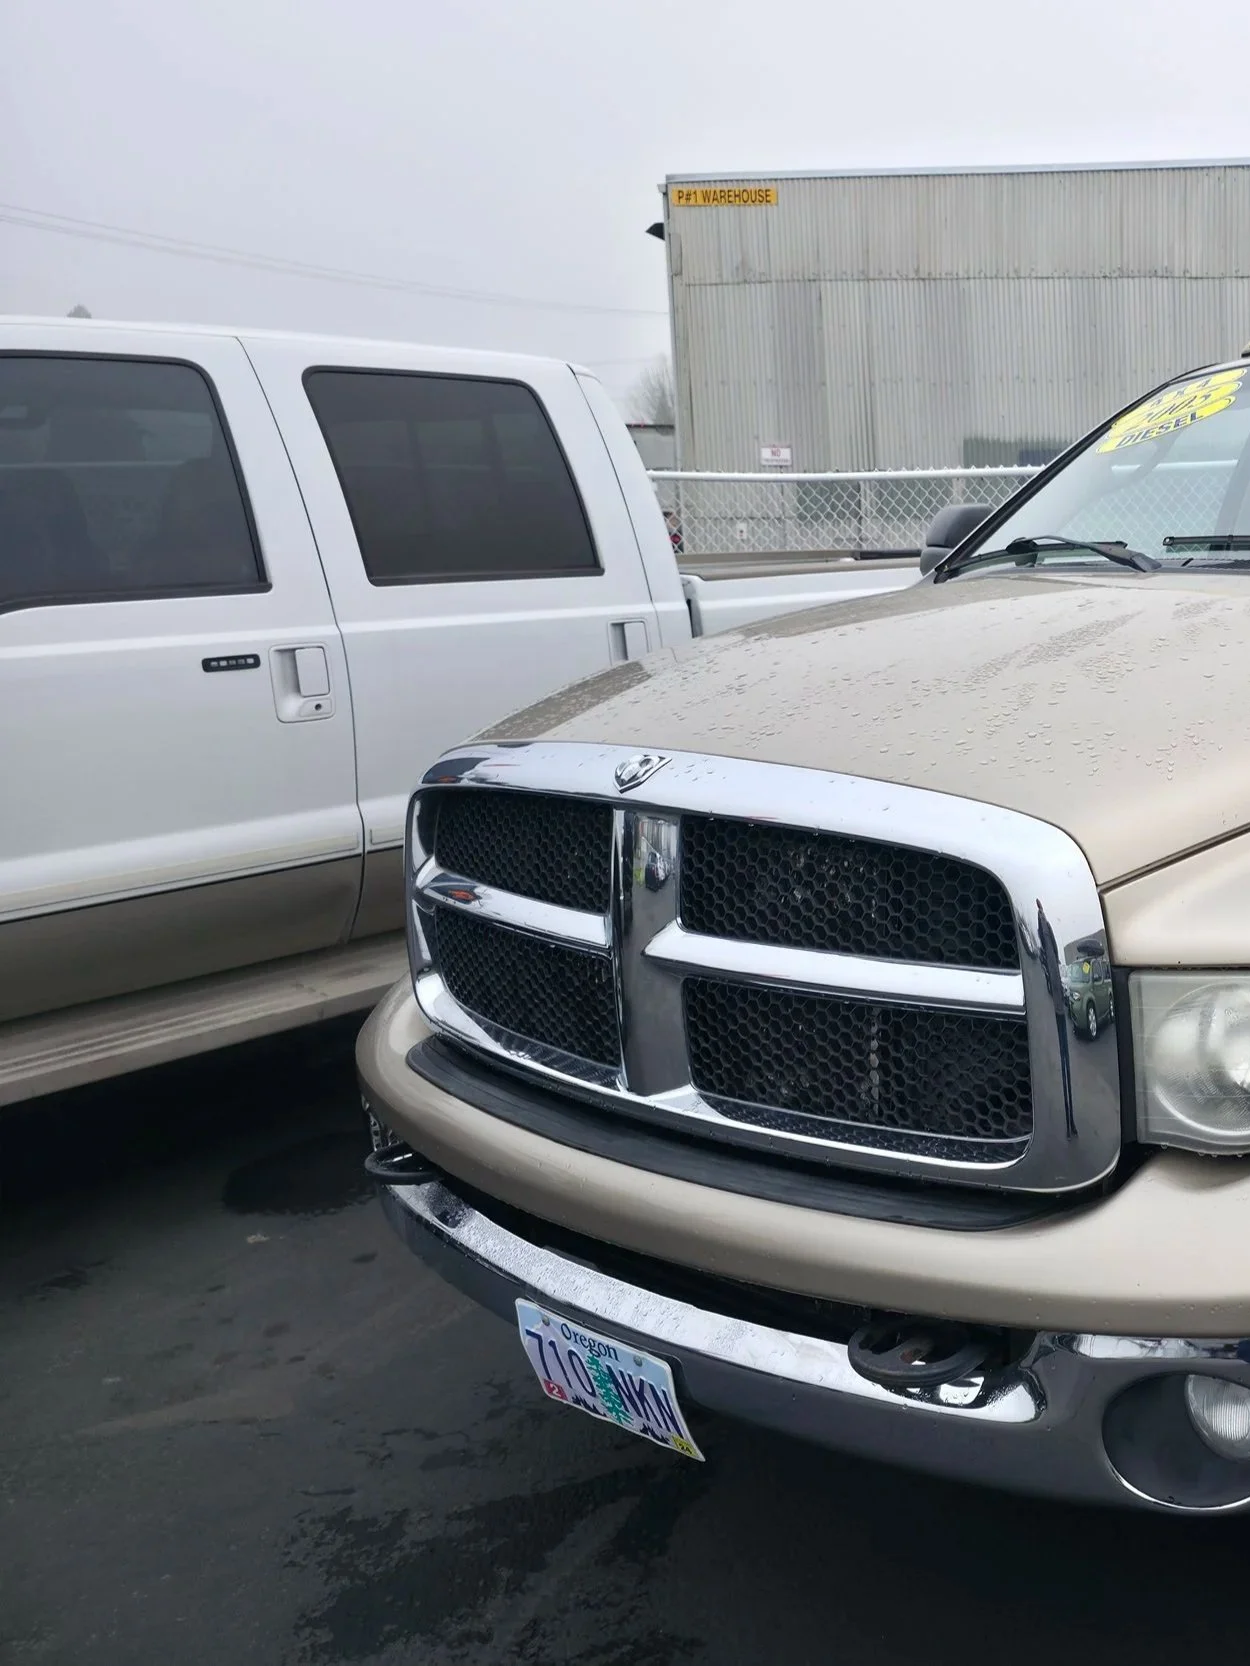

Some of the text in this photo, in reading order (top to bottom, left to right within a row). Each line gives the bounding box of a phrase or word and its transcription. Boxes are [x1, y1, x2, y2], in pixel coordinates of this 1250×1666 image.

[677, 188, 772, 204] P#1 WAREHOUSE
[1115, 411, 1204, 448] DIESEL
[560, 1322, 621, 1363] Oregon
[550, 1383, 562, 1398] 2
